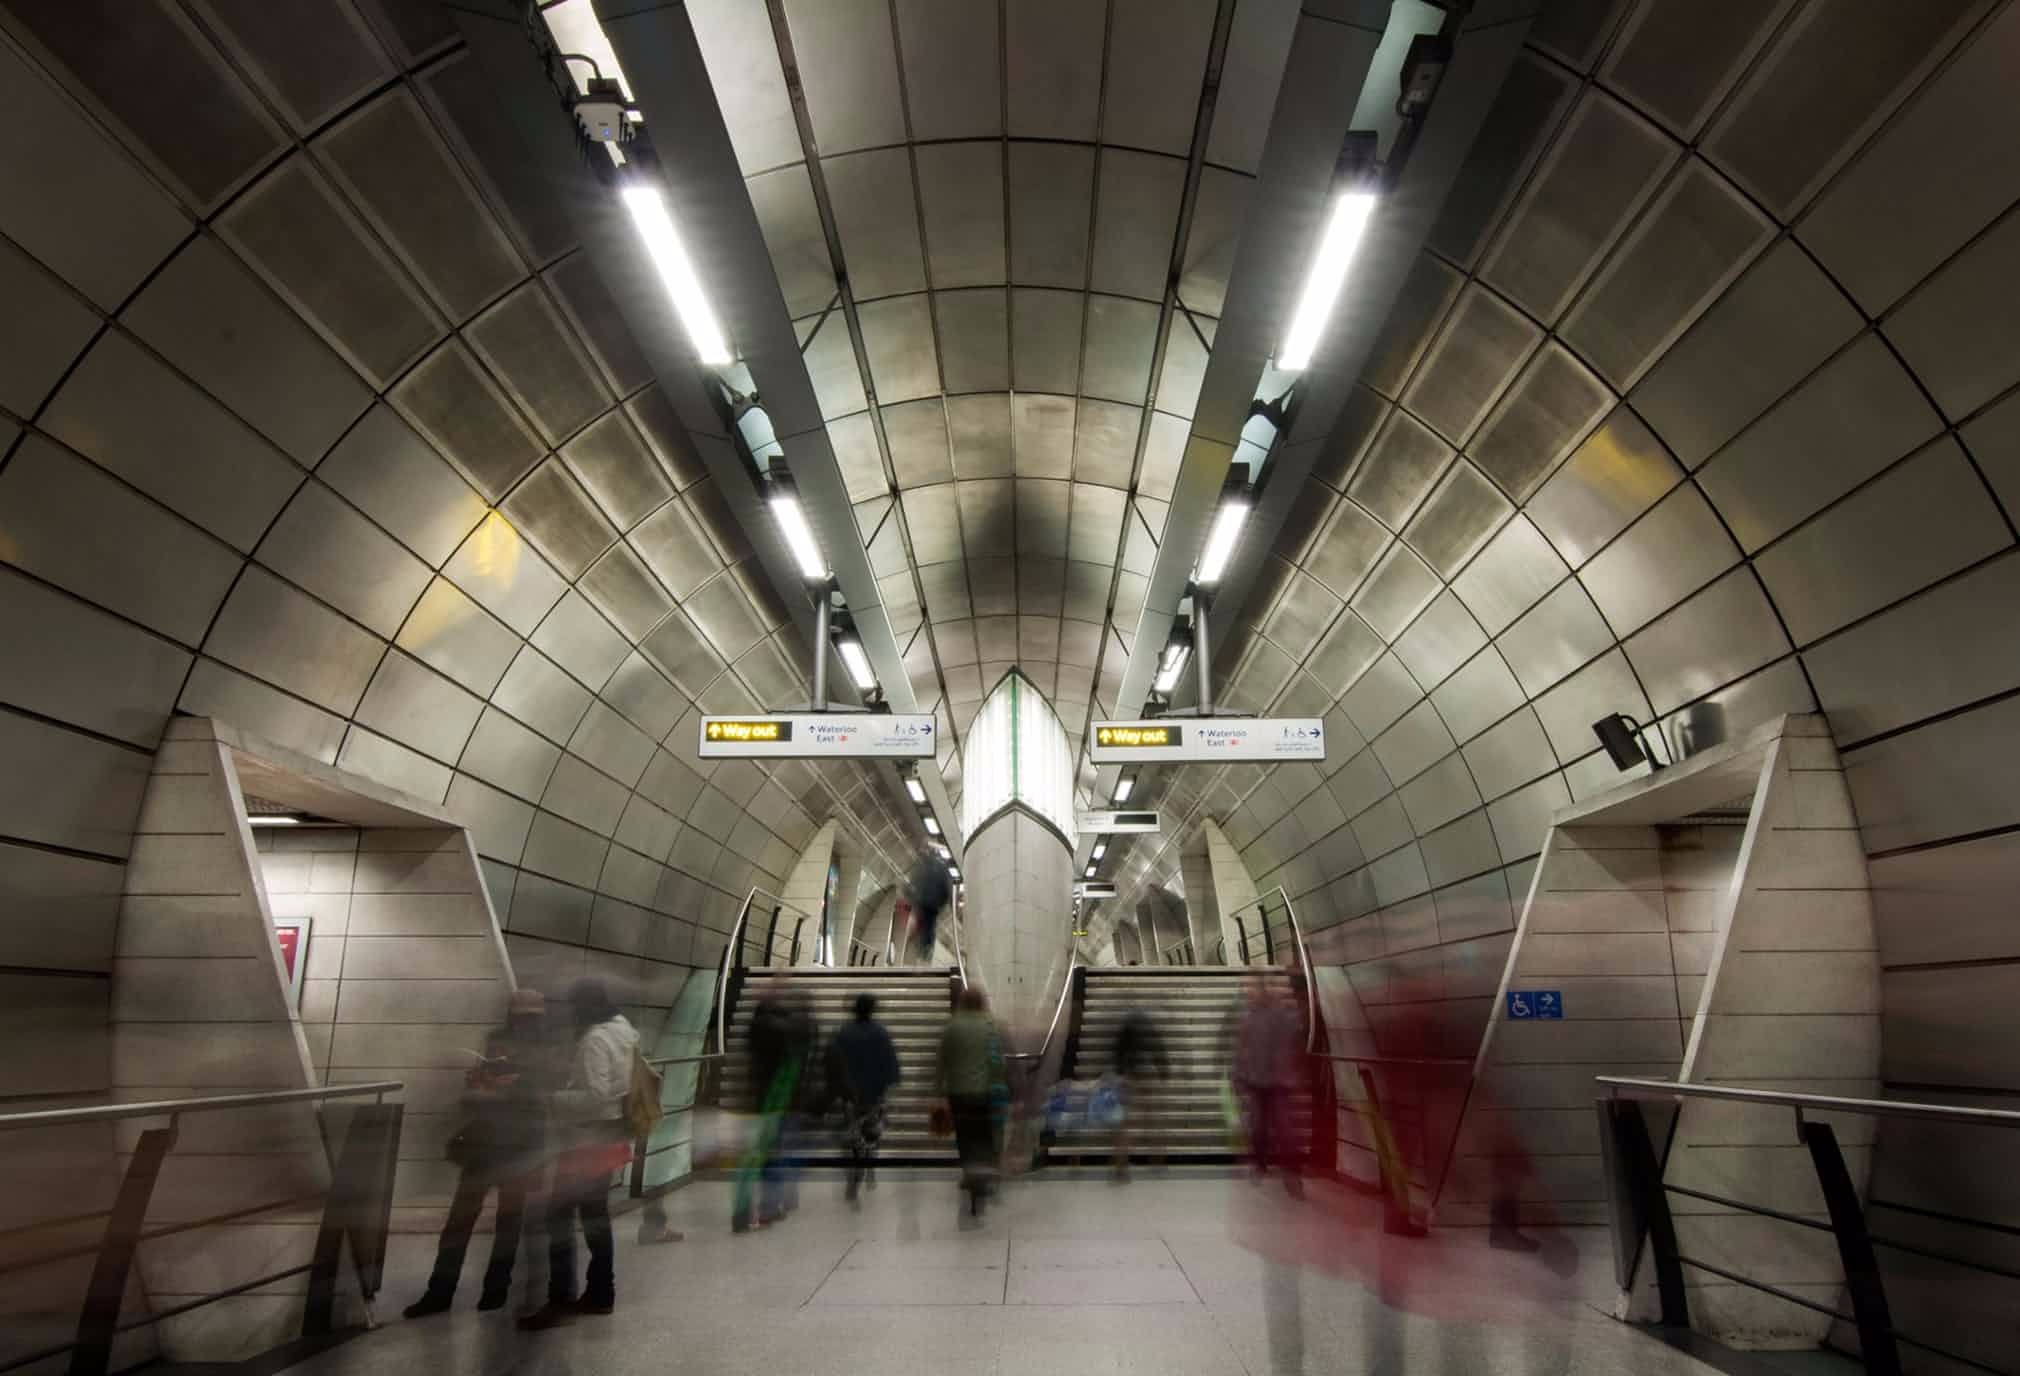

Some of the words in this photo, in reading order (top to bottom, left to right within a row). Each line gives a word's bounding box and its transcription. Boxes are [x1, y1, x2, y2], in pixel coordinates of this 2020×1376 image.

[722, 723, 750, 740] Way
[752, 725, 778, 738] out
[817, 725, 857, 734] Waterloo
[1207, 729, 1248, 738] Waterloo
[817, 735, 835, 743] East
[1113, 728, 1141, 744] Way
[1143, 730, 1168, 742] out
[1207, 739, 1225, 747] East
